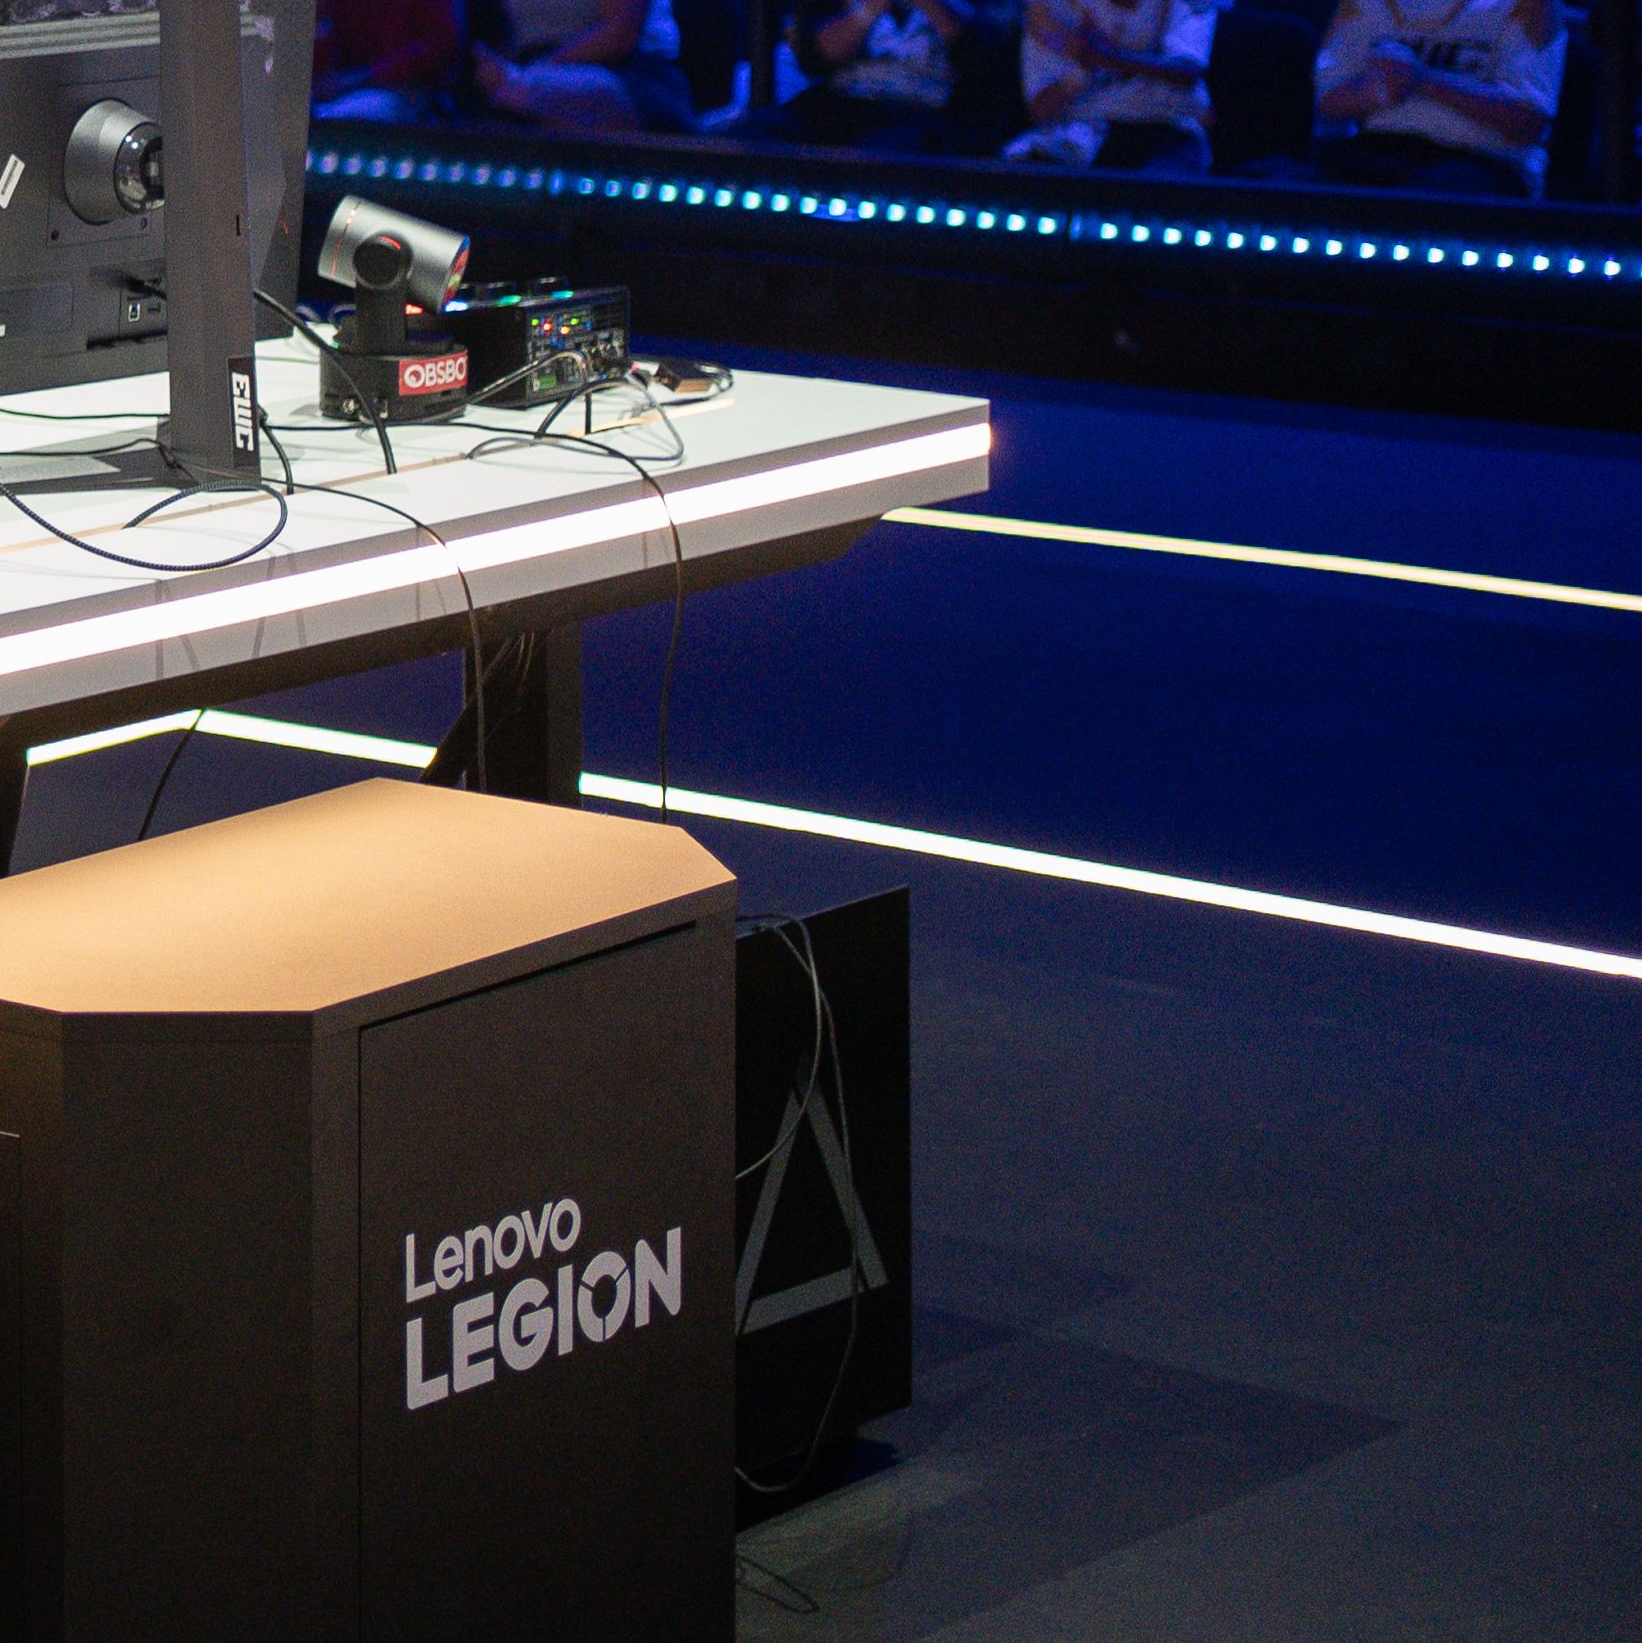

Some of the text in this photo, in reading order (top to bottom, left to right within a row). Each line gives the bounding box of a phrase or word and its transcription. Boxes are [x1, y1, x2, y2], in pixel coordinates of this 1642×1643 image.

[232, 372, 254, 451] EWC
[404, 356, 468, 389] OBSBO
[406, 1198, 581, 1303] Lenovo
[406, 1226, 682, 1410] LEGION
